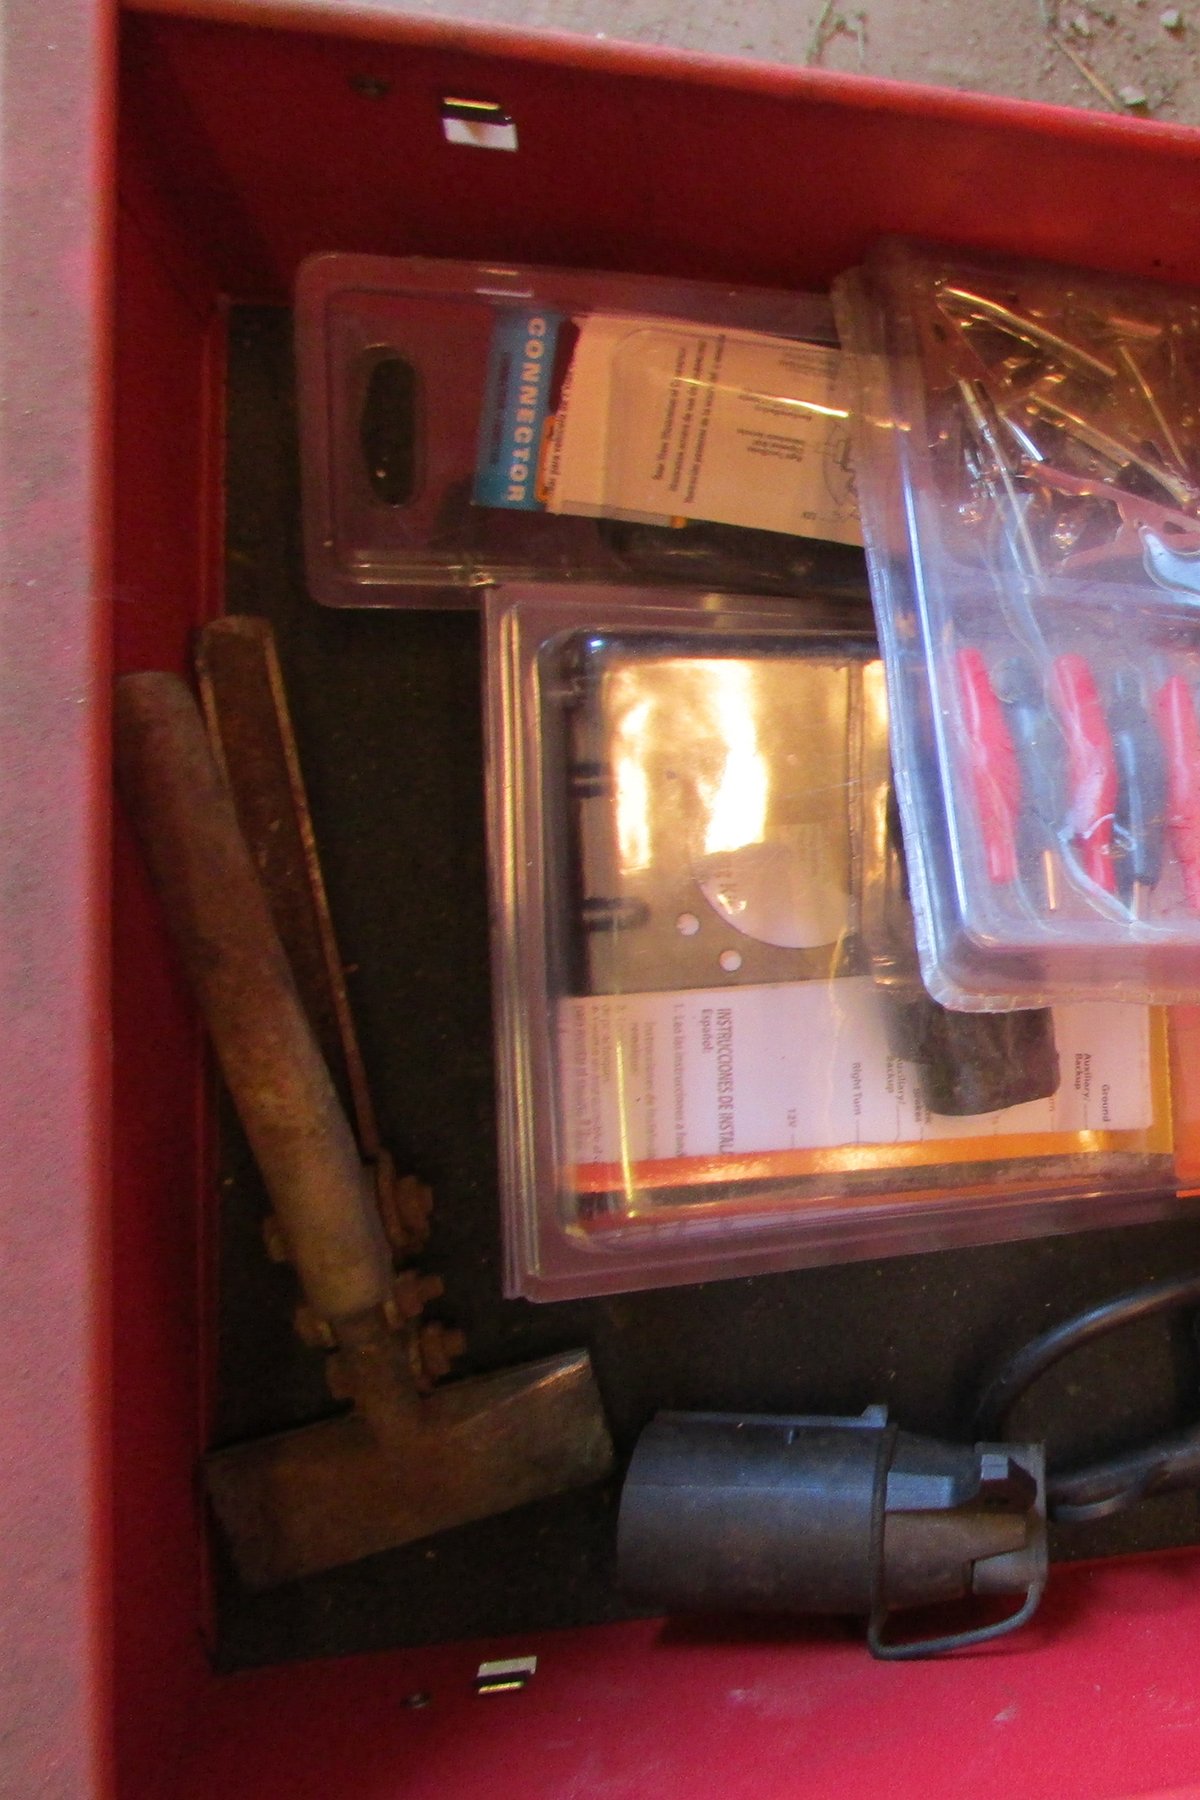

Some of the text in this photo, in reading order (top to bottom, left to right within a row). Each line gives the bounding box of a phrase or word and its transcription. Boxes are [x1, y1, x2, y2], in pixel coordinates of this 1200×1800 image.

[506, 316, 547, 503] CONNECTOR
[717, 1008, 733, 1093] INSTRUCCIONES
[1074, 1053, 1083, 1090] Backup
[718, 1095, 733, 1110] DE
[850, 1063, 863, 1115] Right Turn
[1101, 1084, 1111, 1122] Ground
